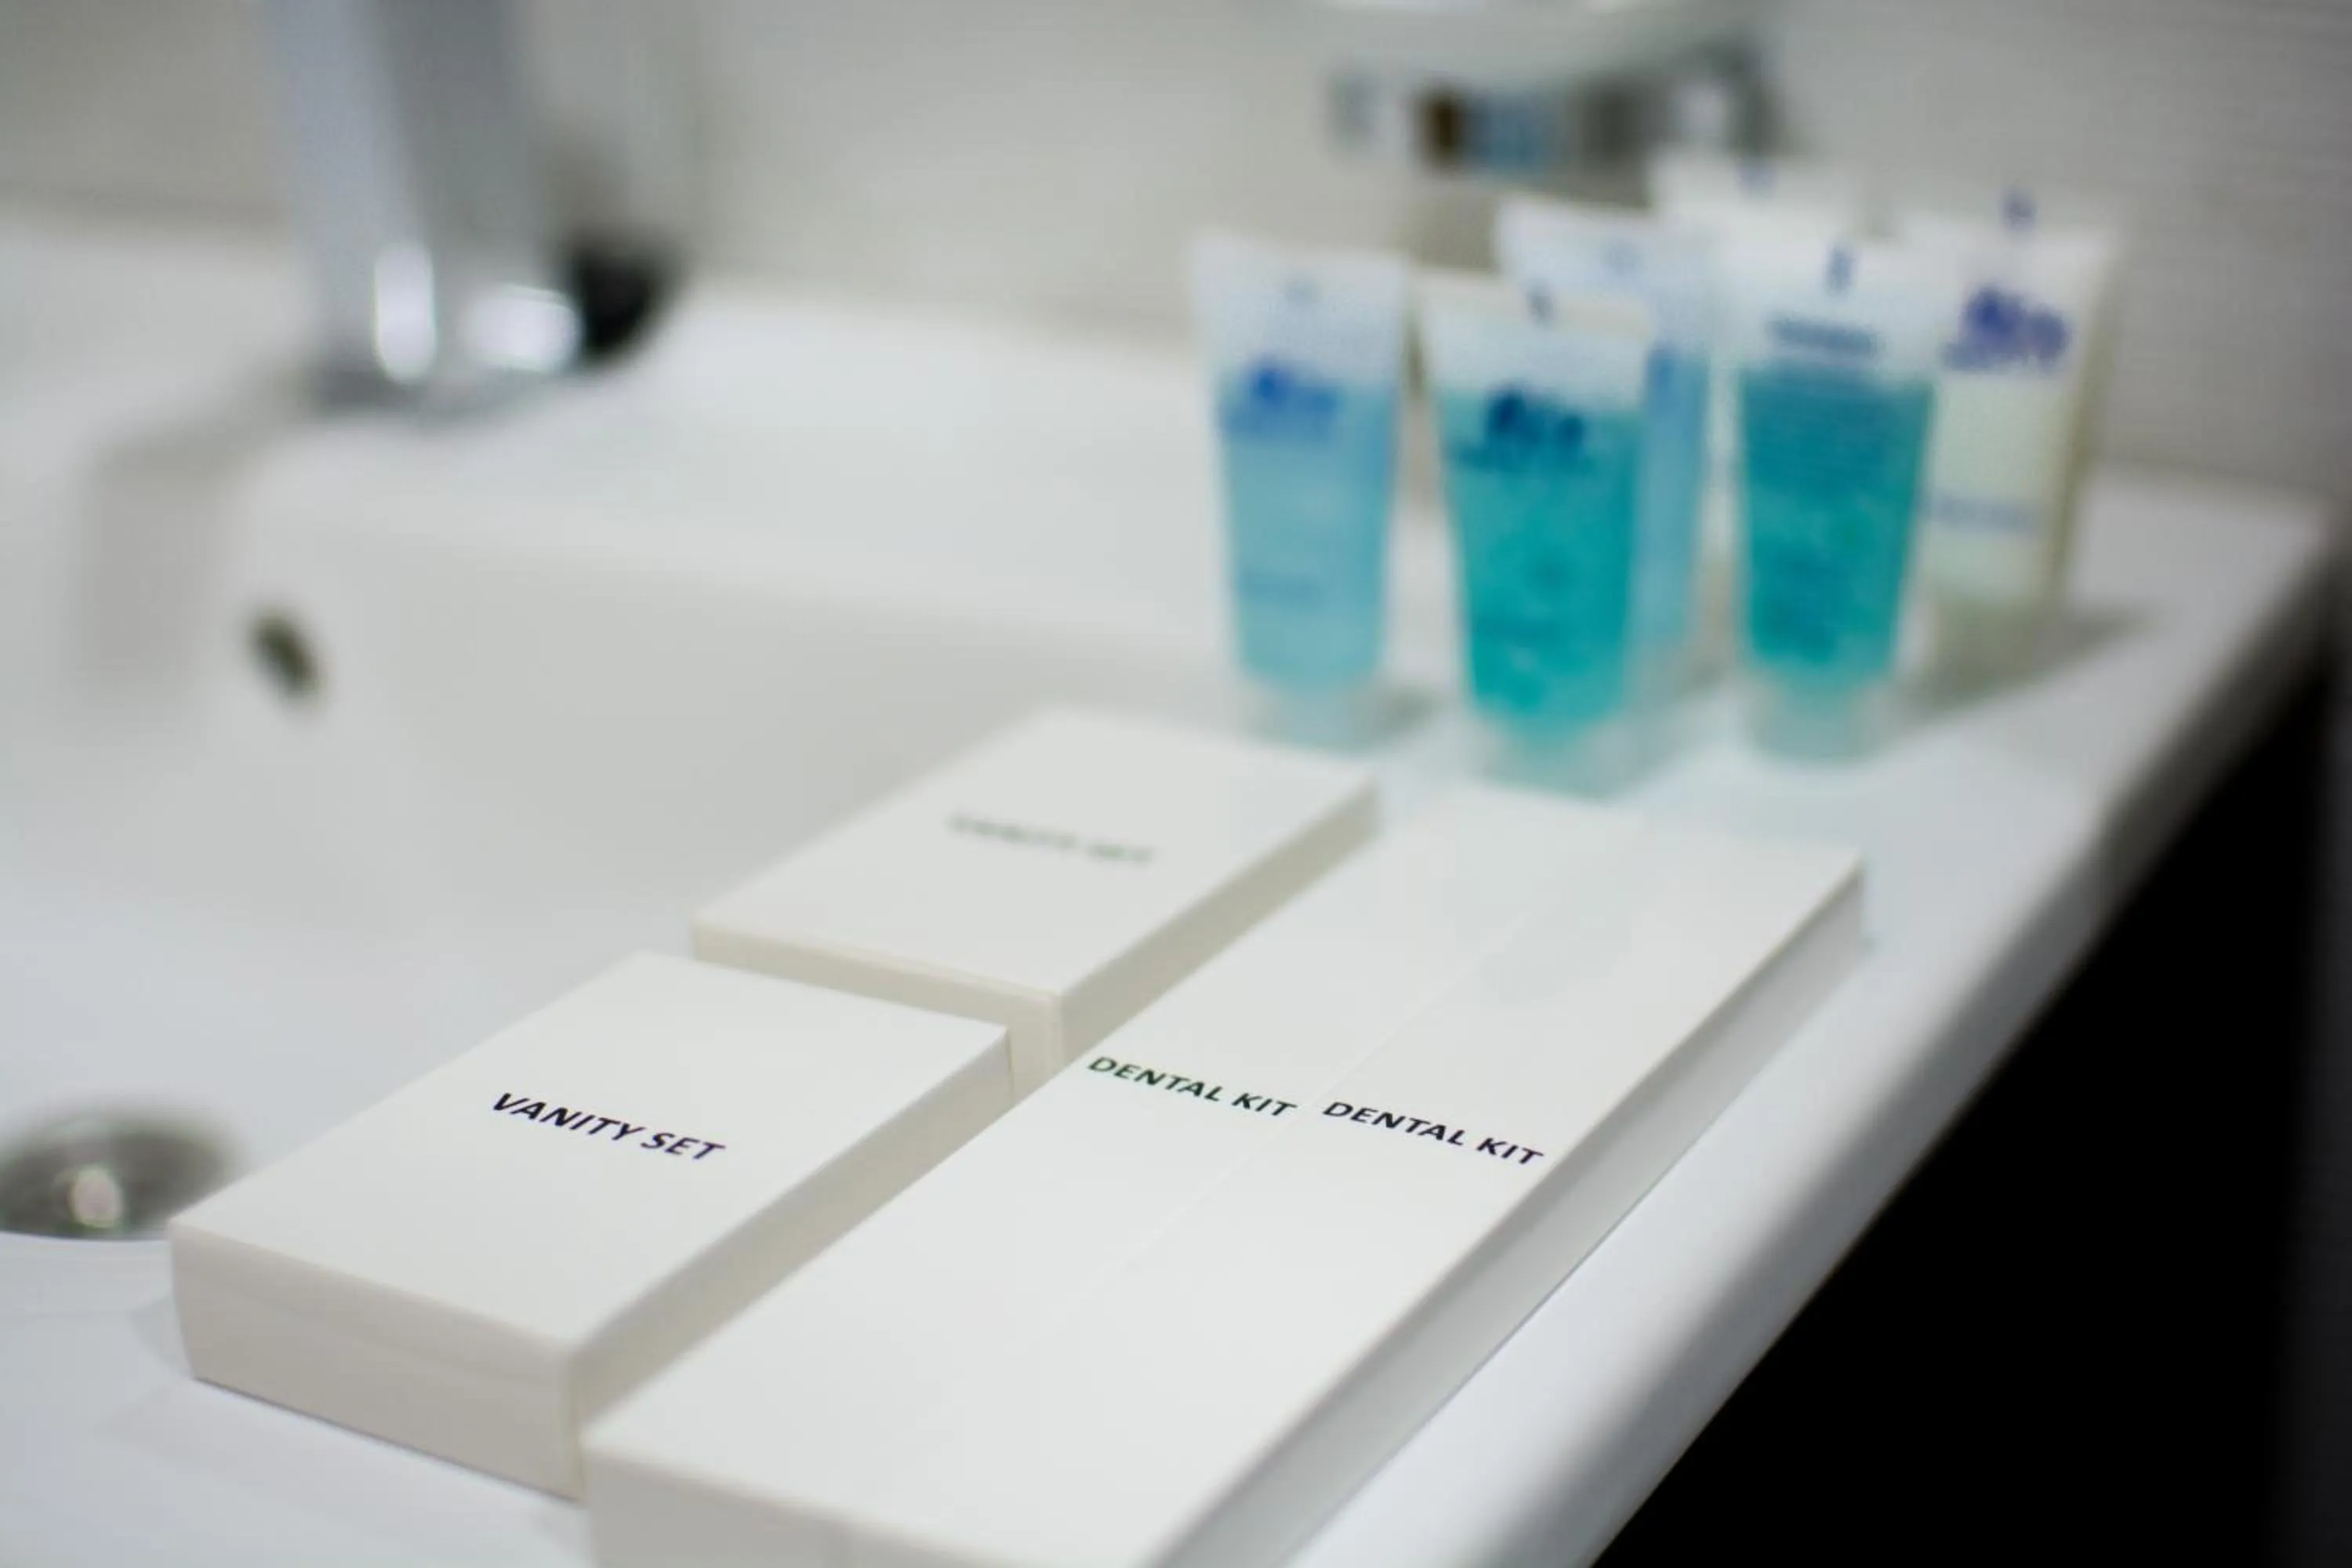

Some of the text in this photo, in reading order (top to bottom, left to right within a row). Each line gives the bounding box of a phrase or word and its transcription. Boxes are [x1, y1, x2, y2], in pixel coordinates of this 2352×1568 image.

[1087, 1056, 1298, 1117] DENTAL KIT
[492, 1092, 727, 1160] VANITY SET
[1322, 1101, 1545, 1166] DENTAL KIT
